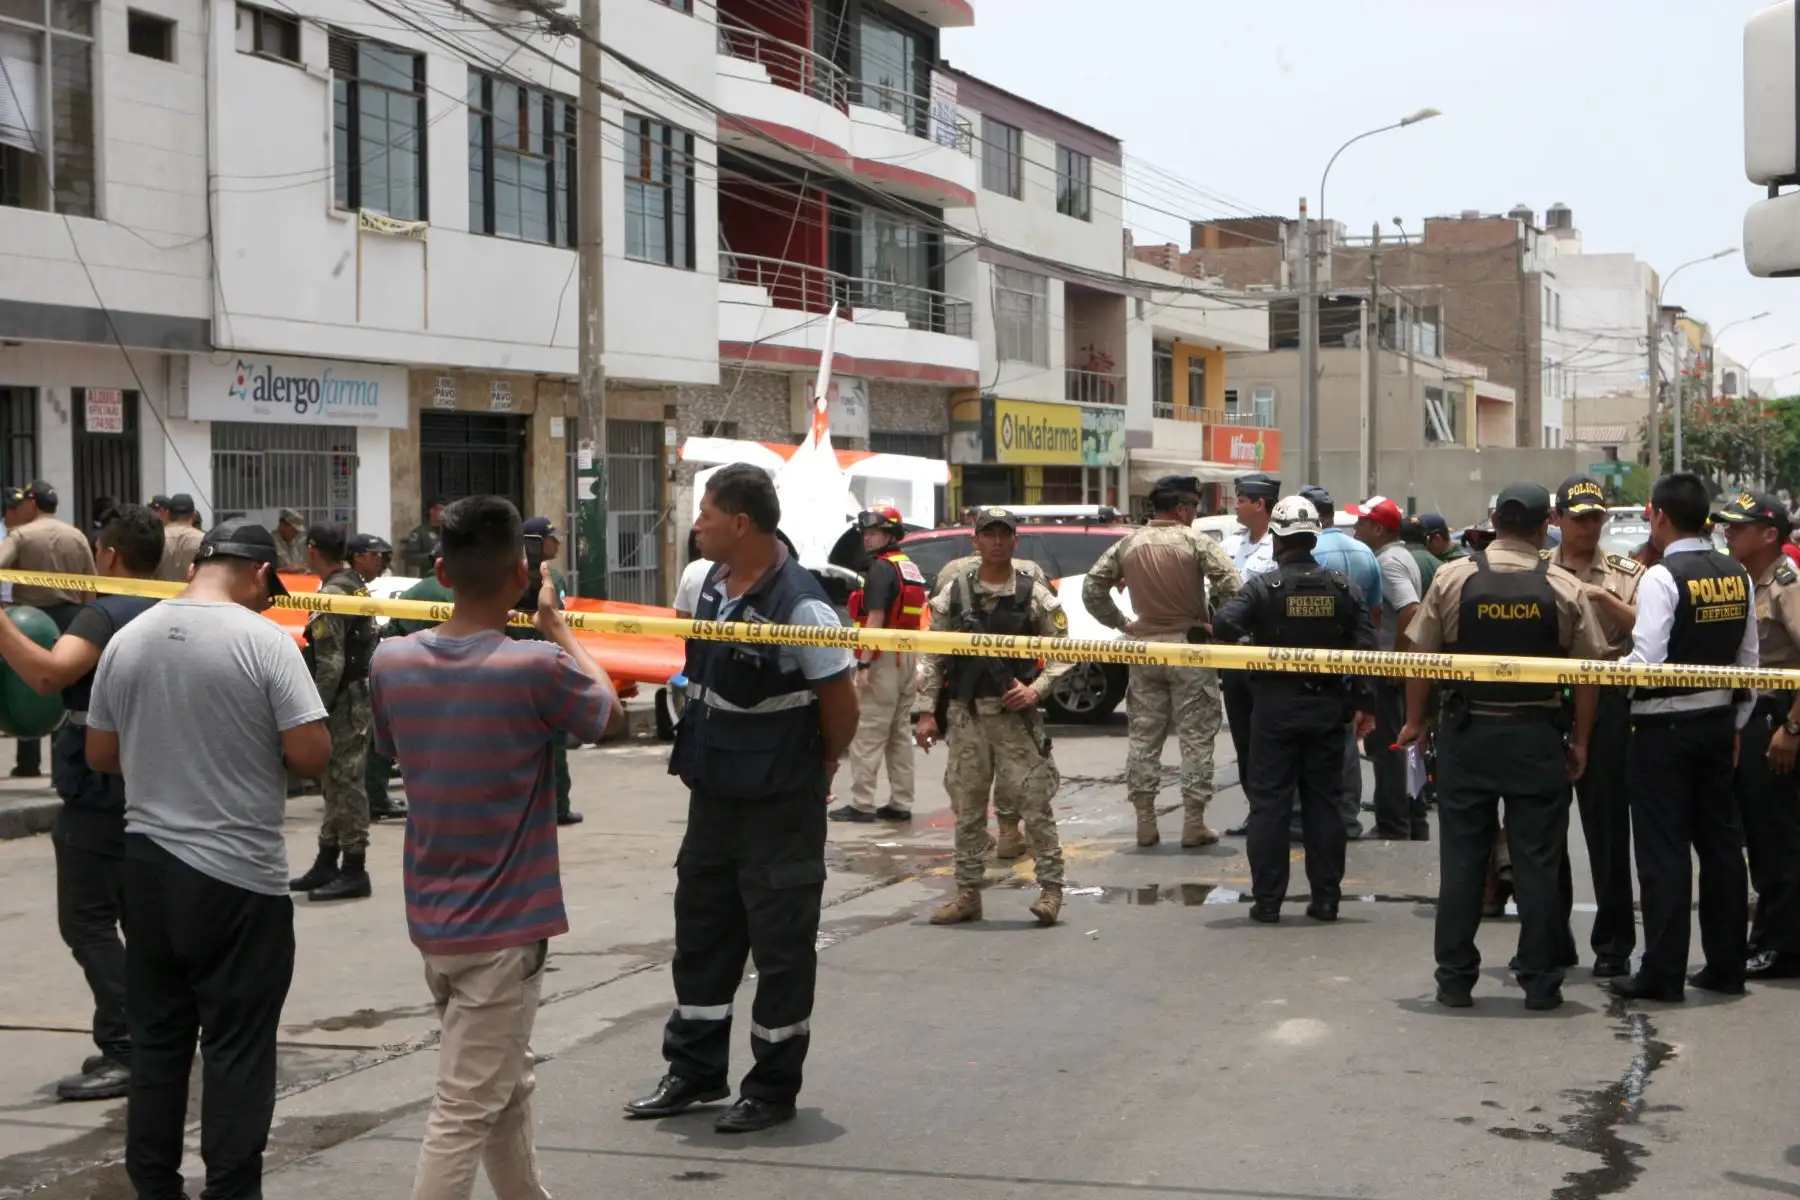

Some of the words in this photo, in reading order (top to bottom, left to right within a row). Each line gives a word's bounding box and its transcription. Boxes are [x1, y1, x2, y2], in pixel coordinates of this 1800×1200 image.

[88, 389, 122, 404] ALQUILO
[252, 365, 379, 415] alergofarma
[435, 387, 455, 398] PAVO
[492, 391, 512, 401] PAVO
[1014, 415, 1078, 452] Inkafarma
[1567, 482, 1604, 500] POLICIA
[1288, 597, 1333, 606] POLICIA
[1289, 606, 1332, 617] RESCATE
[1477, 602, 1542, 620] POLICIA
[692, 620, 737, 637] PASO
[746, 623, 761, 638] EL
[769, 625, 860, 642] PROHIBIDO
[970, 633, 1016, 649] PASO
[1050, 637, 1148, 654] PROHIBIDO
[1267, 646, 1317, 662] PASO
[1738, 676, 1796, 689] OLICIA
